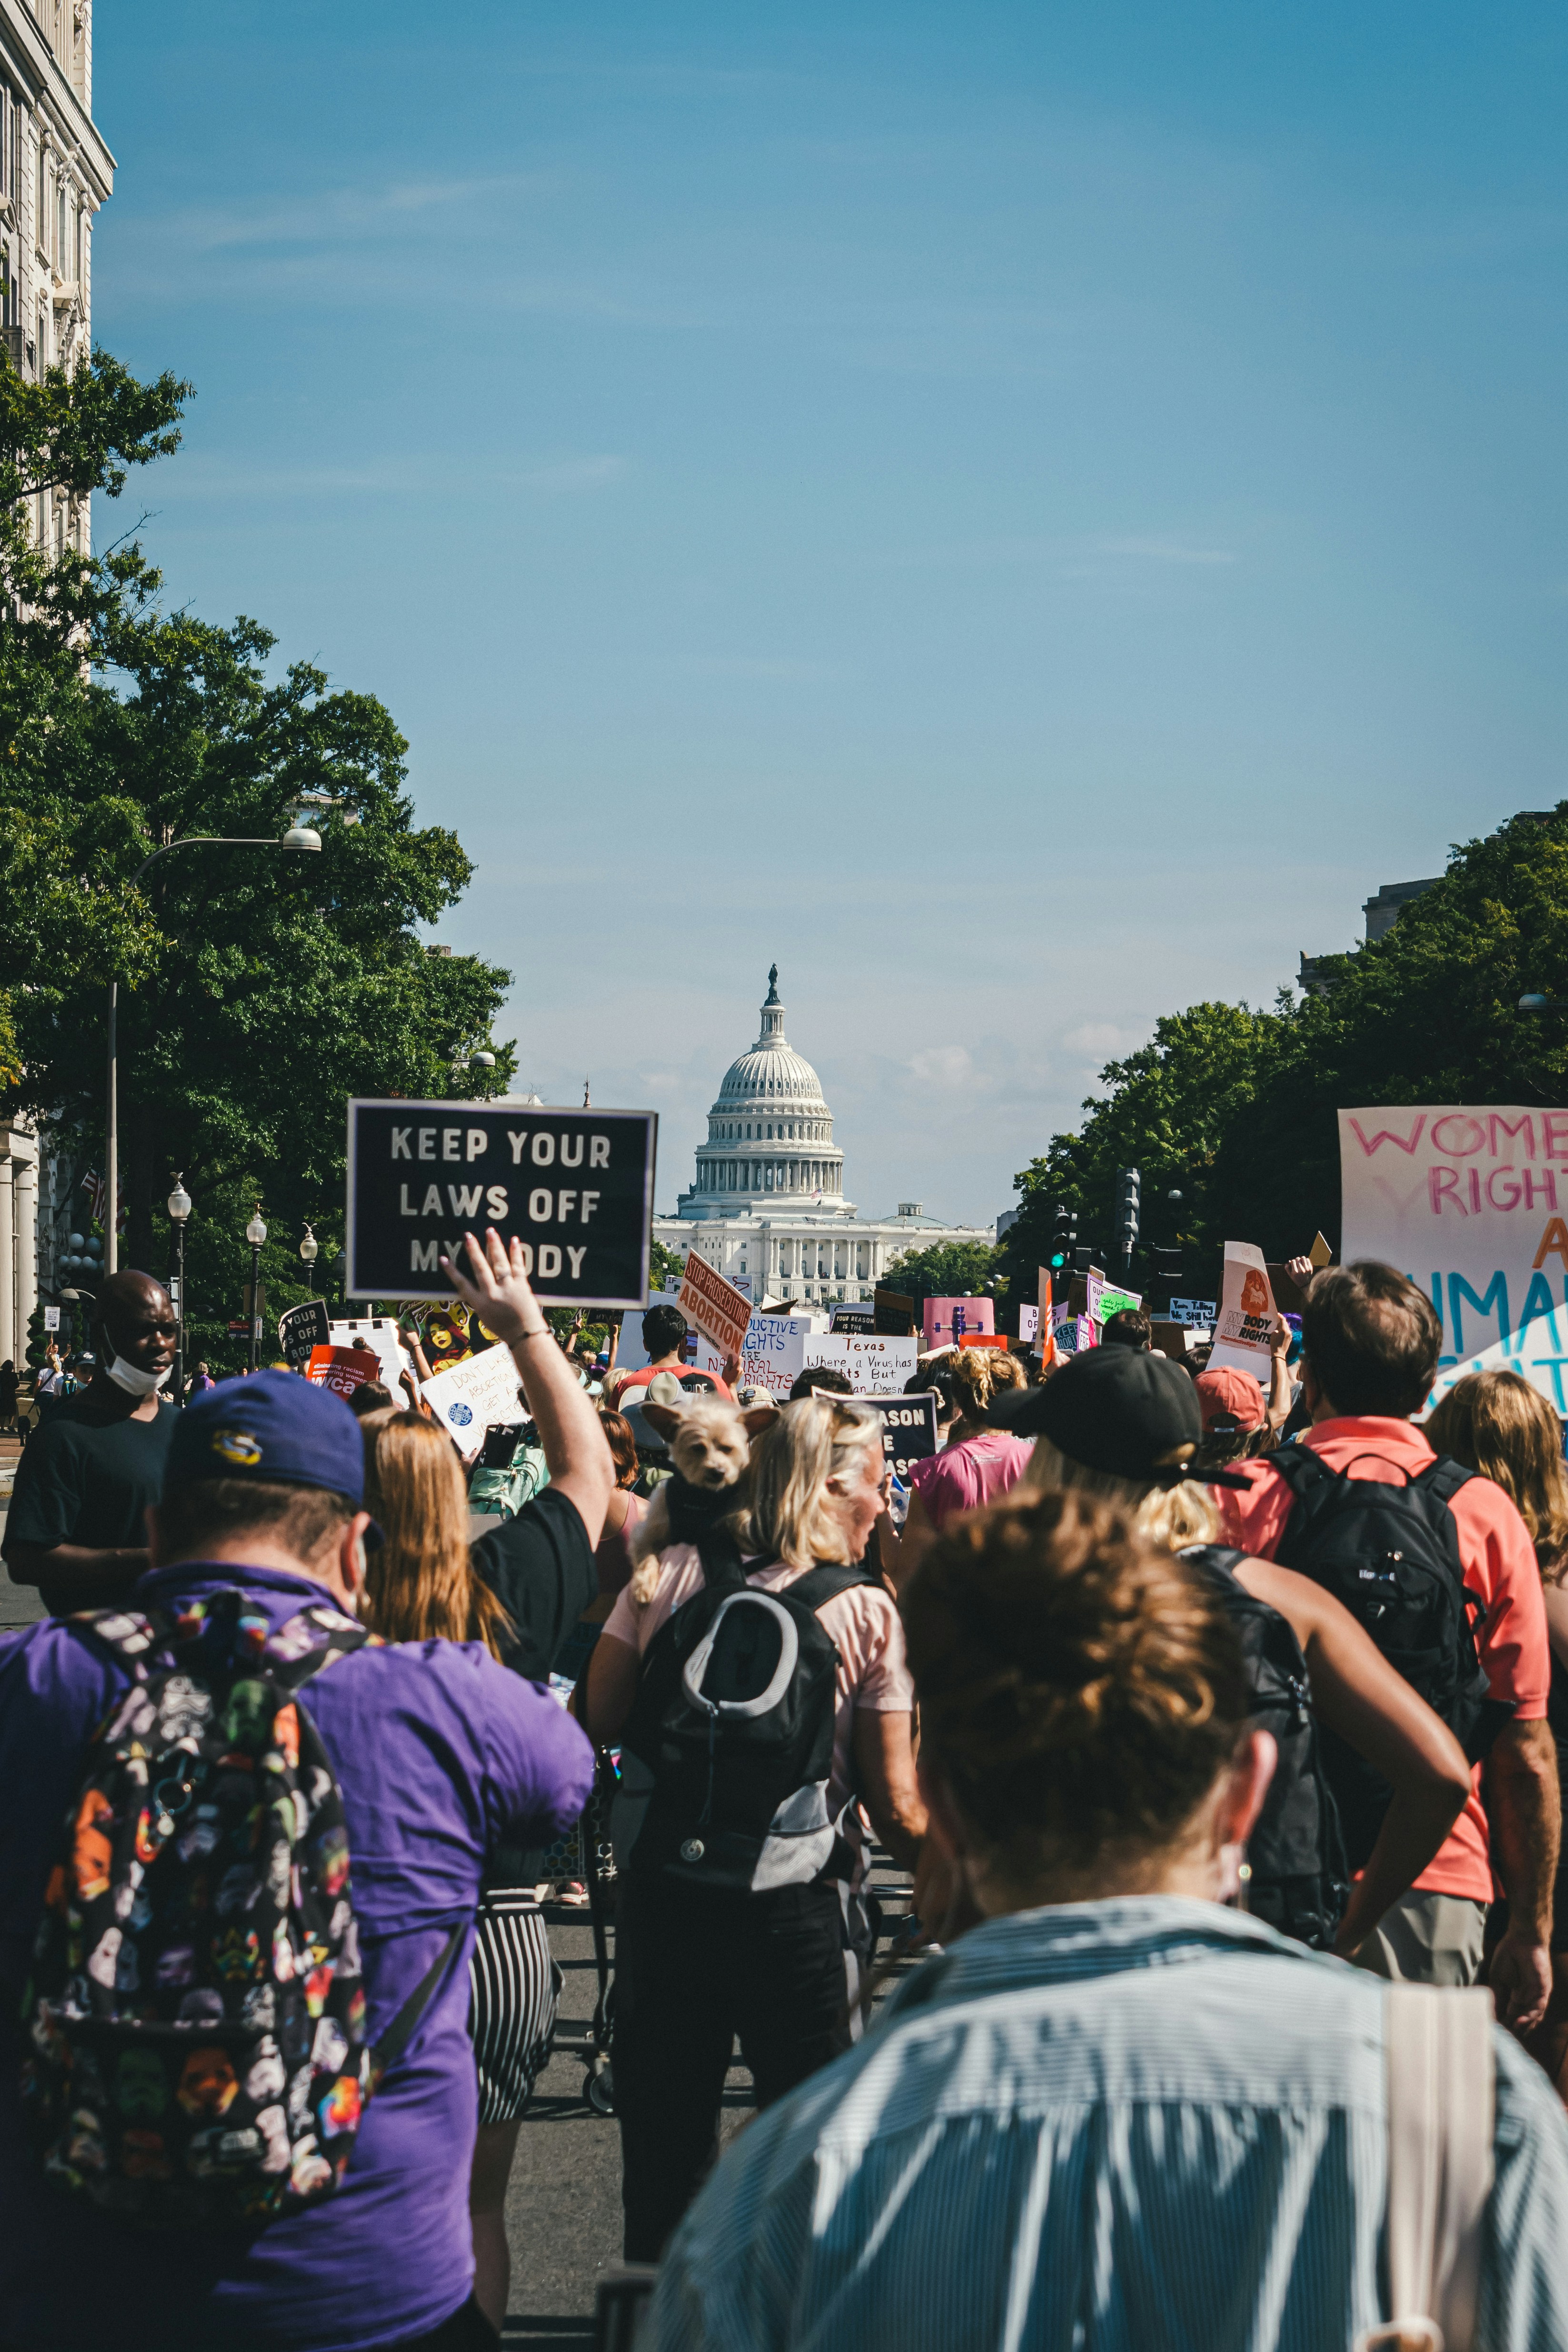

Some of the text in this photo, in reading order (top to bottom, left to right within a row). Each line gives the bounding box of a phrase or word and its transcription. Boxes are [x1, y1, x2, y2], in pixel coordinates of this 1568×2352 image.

[391, 1127, 611, 1168] KEEP YOUR
[1428, 1165, 1568, 1216] RIGH
[400, 1184, 600, 1223] LAWS OFF
[410, 1240, 587, 1279] MY ODY
[687, 1257, 749, 1328] STOP PROSECUTING
[287, 1310, 317, 1327] YOUR
[679, 1284, 743, 1354] ABORTION
[850, 1316, 874, 1324] REASON
[1186, 1311, 1201, 1321] Still
[1226, 1310, 1273, 1331] MY BODY
[298, 1325, 317, 1339] OFF
[695, 1322, 720, 1351] Reproaction
[1222, 1322, 1242, 1336] MY
[1238, 1326, 1271, 1345] RIGHTS
[842, 1337, 886, 1351] Texas
[708, 1357, 778, 1375] NARAL
[807, 1355, 847, 1367] Where
[868, 1355, 893, 1367] Virus
[896, 1355, 912, 1368] has
[343, 1366, 364, 1376] racism
[450, 1353, 512, 1389] DON'T LIKE
[871, 1368, 897, 1379] But
[744, 1373, 794, 1390] RIGHTS
[482, 1386, 513, 1411] GET A
[449, 1405, 457, 1419] KEEP
[878, 1409, 925, 1426] ASON
